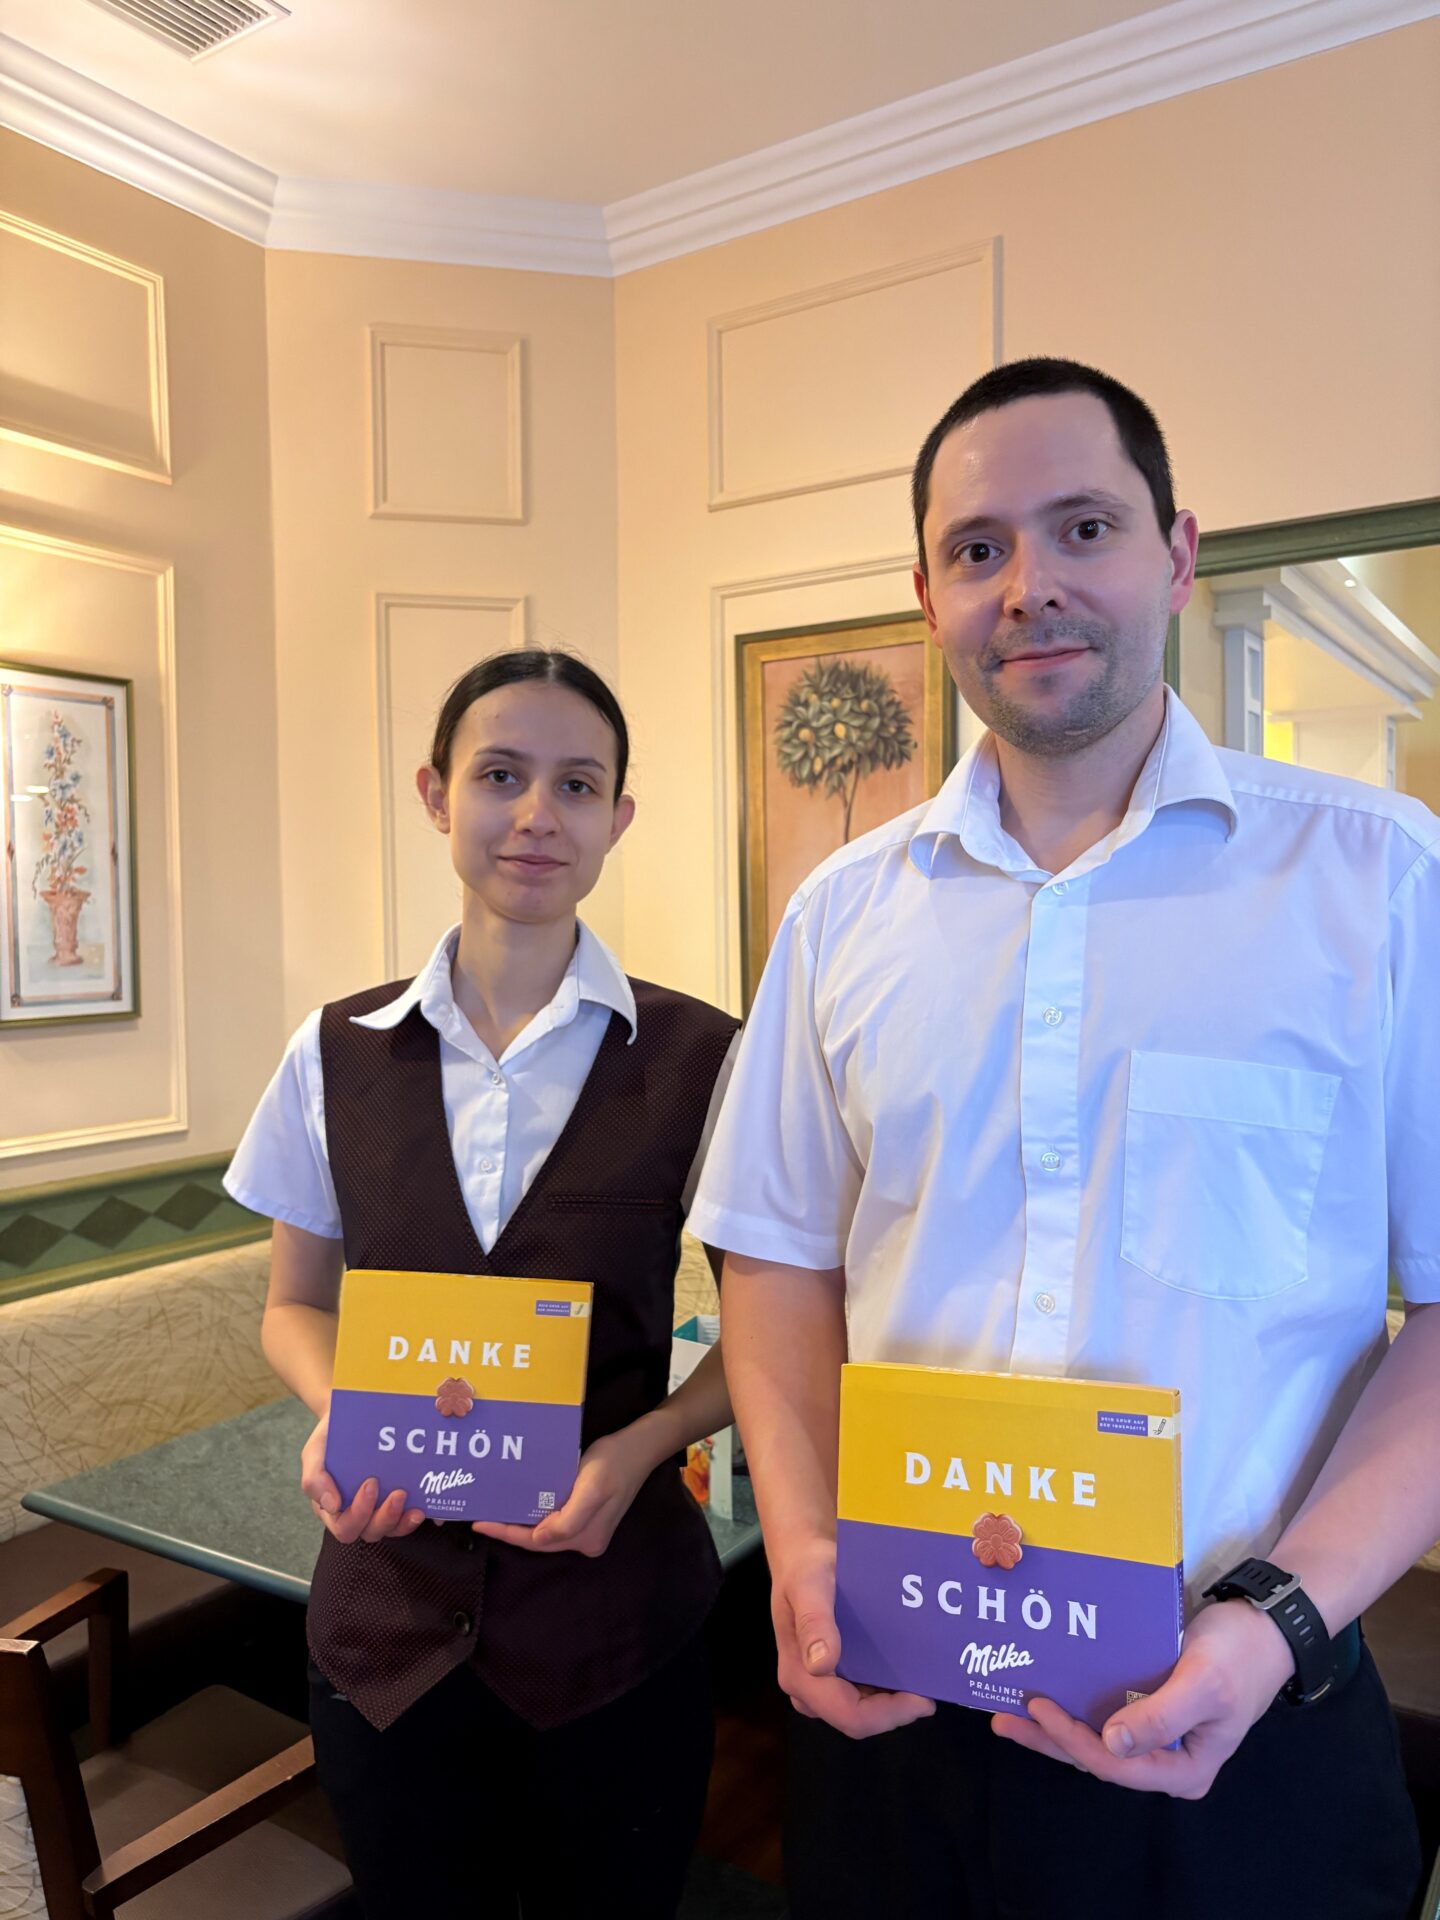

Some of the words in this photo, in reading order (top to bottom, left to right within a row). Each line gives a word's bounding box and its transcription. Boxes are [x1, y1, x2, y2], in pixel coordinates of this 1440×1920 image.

[388, 1335, 531, 1368] DANKE
[378, 1426, 524, 1460] SCHÖN
[419, 1468, 476, 1495] Milka
[903, 1451, 1097, 1508] DANKE
[425, 1497, 467, 1507] PRALINES
[901, 1573, 1099, 1640] SCHÖN
[959, 1642, 1035, 1677] Milka
[969, 1680, 1024, 1698] PRALINES
